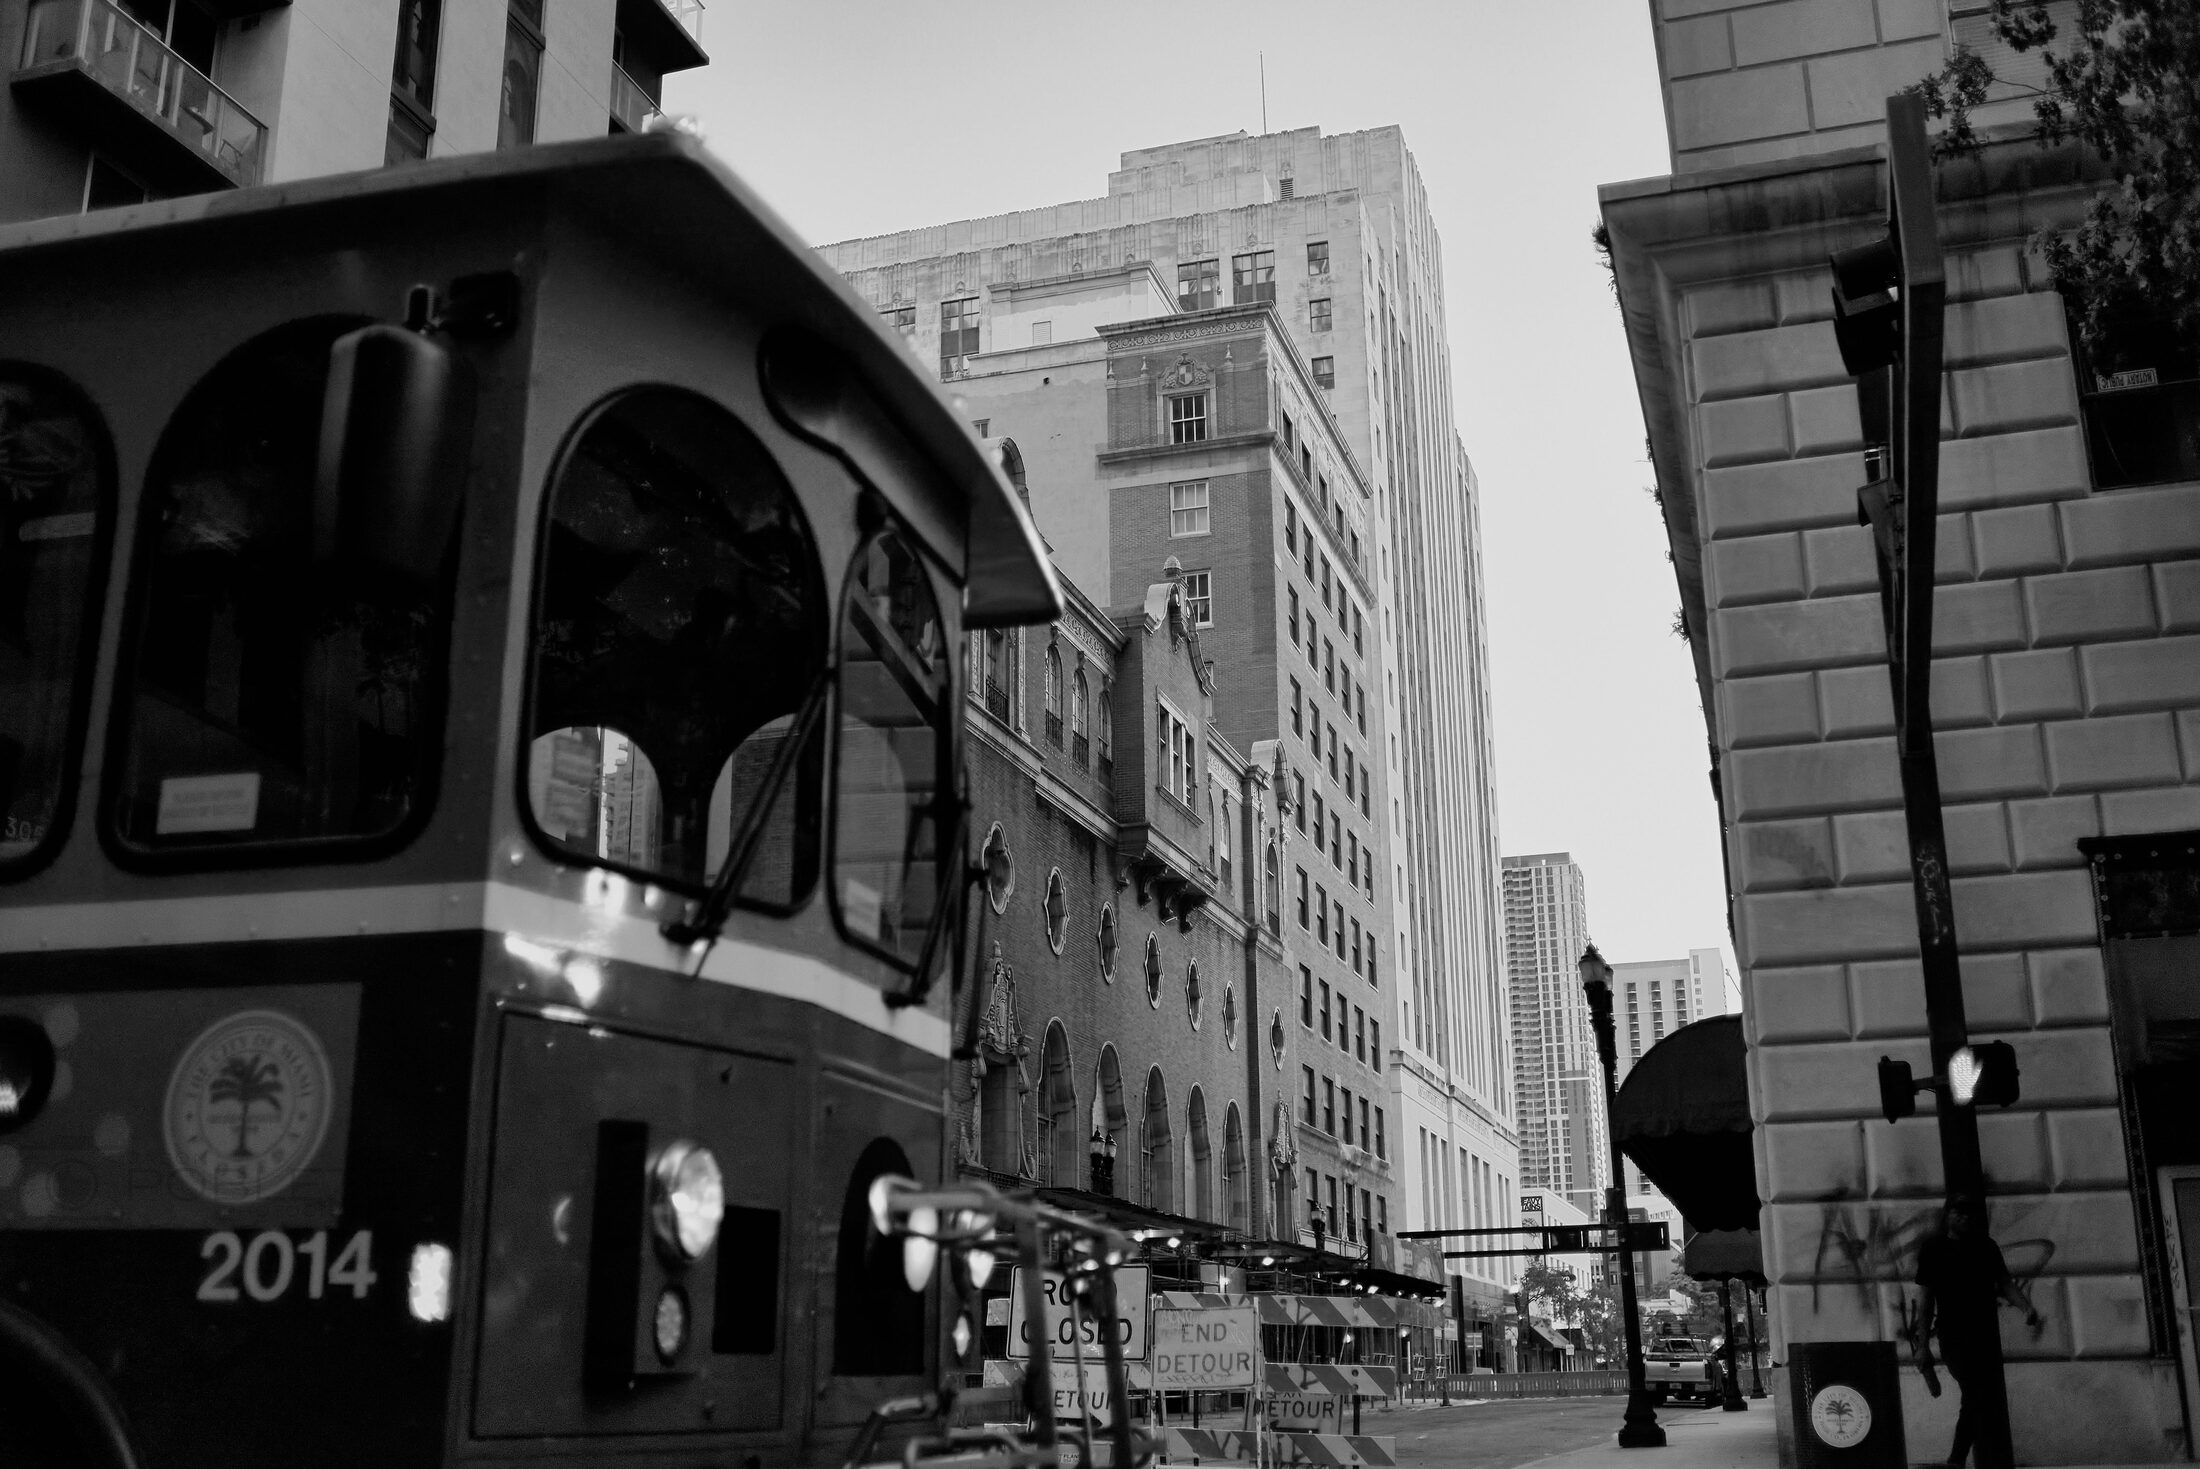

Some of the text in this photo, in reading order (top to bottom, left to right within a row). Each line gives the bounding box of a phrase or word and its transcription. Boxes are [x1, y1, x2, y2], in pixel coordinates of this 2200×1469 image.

[196, 1229, 378, 1301] 2014
[1020, 1317, 1133, 1345] COSED
[1181, 1323, 1227, 1343] END
[1157, 1352, 1250, 1373] DETOUR
[1054, 1390, 1111, 1410] ETOU
[1253, 1400, 1335, 1418] DETOUR
